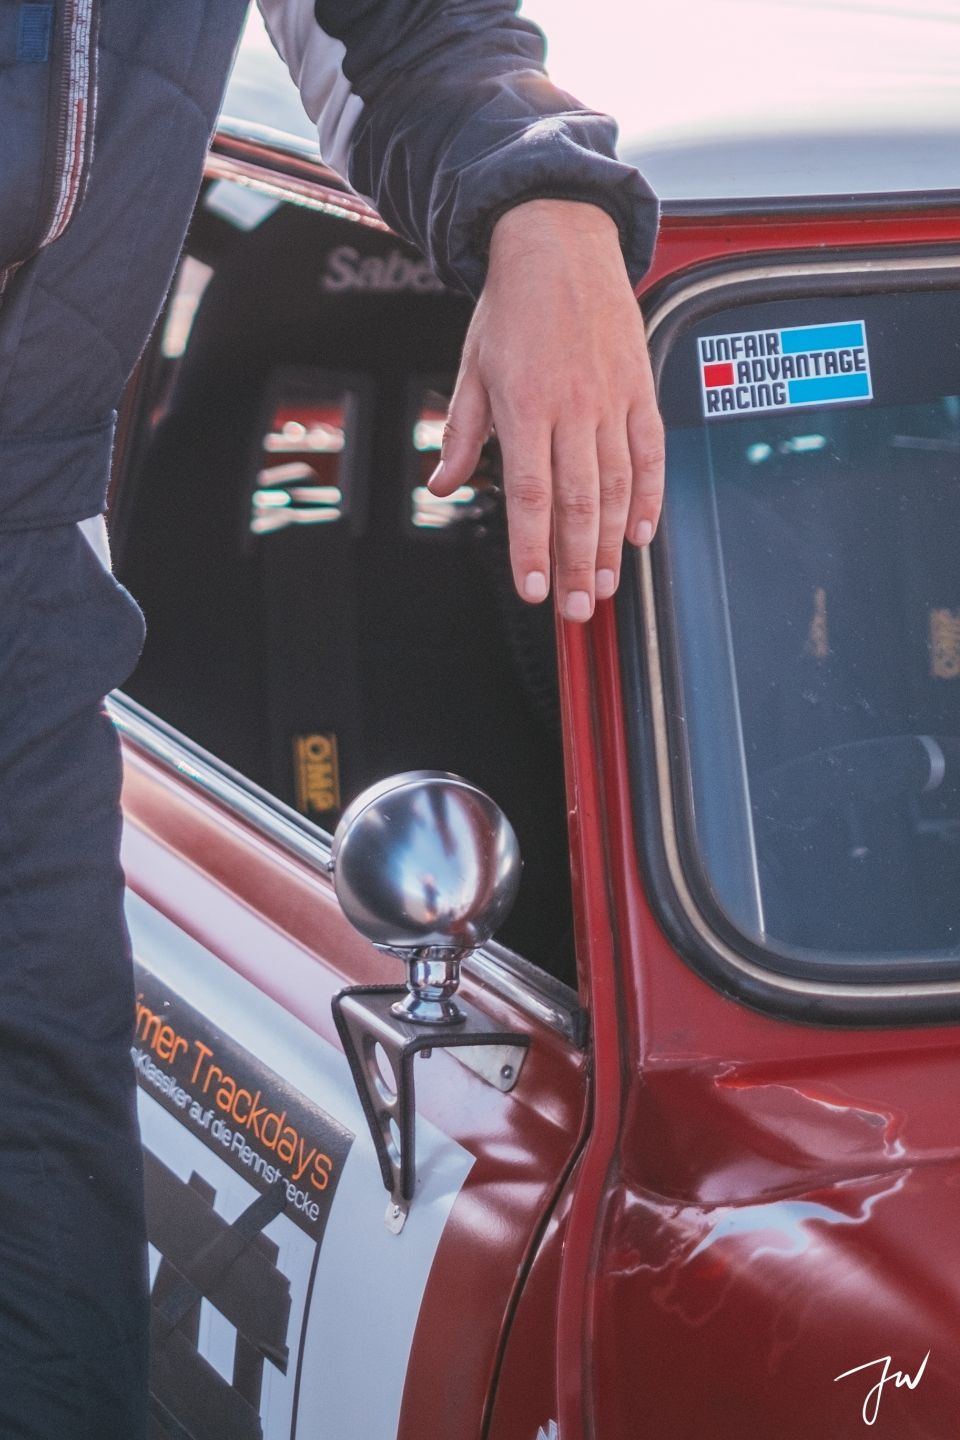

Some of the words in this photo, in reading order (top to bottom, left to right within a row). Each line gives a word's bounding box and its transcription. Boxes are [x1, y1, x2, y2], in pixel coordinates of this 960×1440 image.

[701, 332, 780, 363] UNFAIR
[736, 348, 868, 385] ADVANTAGE
[706, 382, 788, 414] RACING
[191, 1040, 333, 1191] Trackdays
